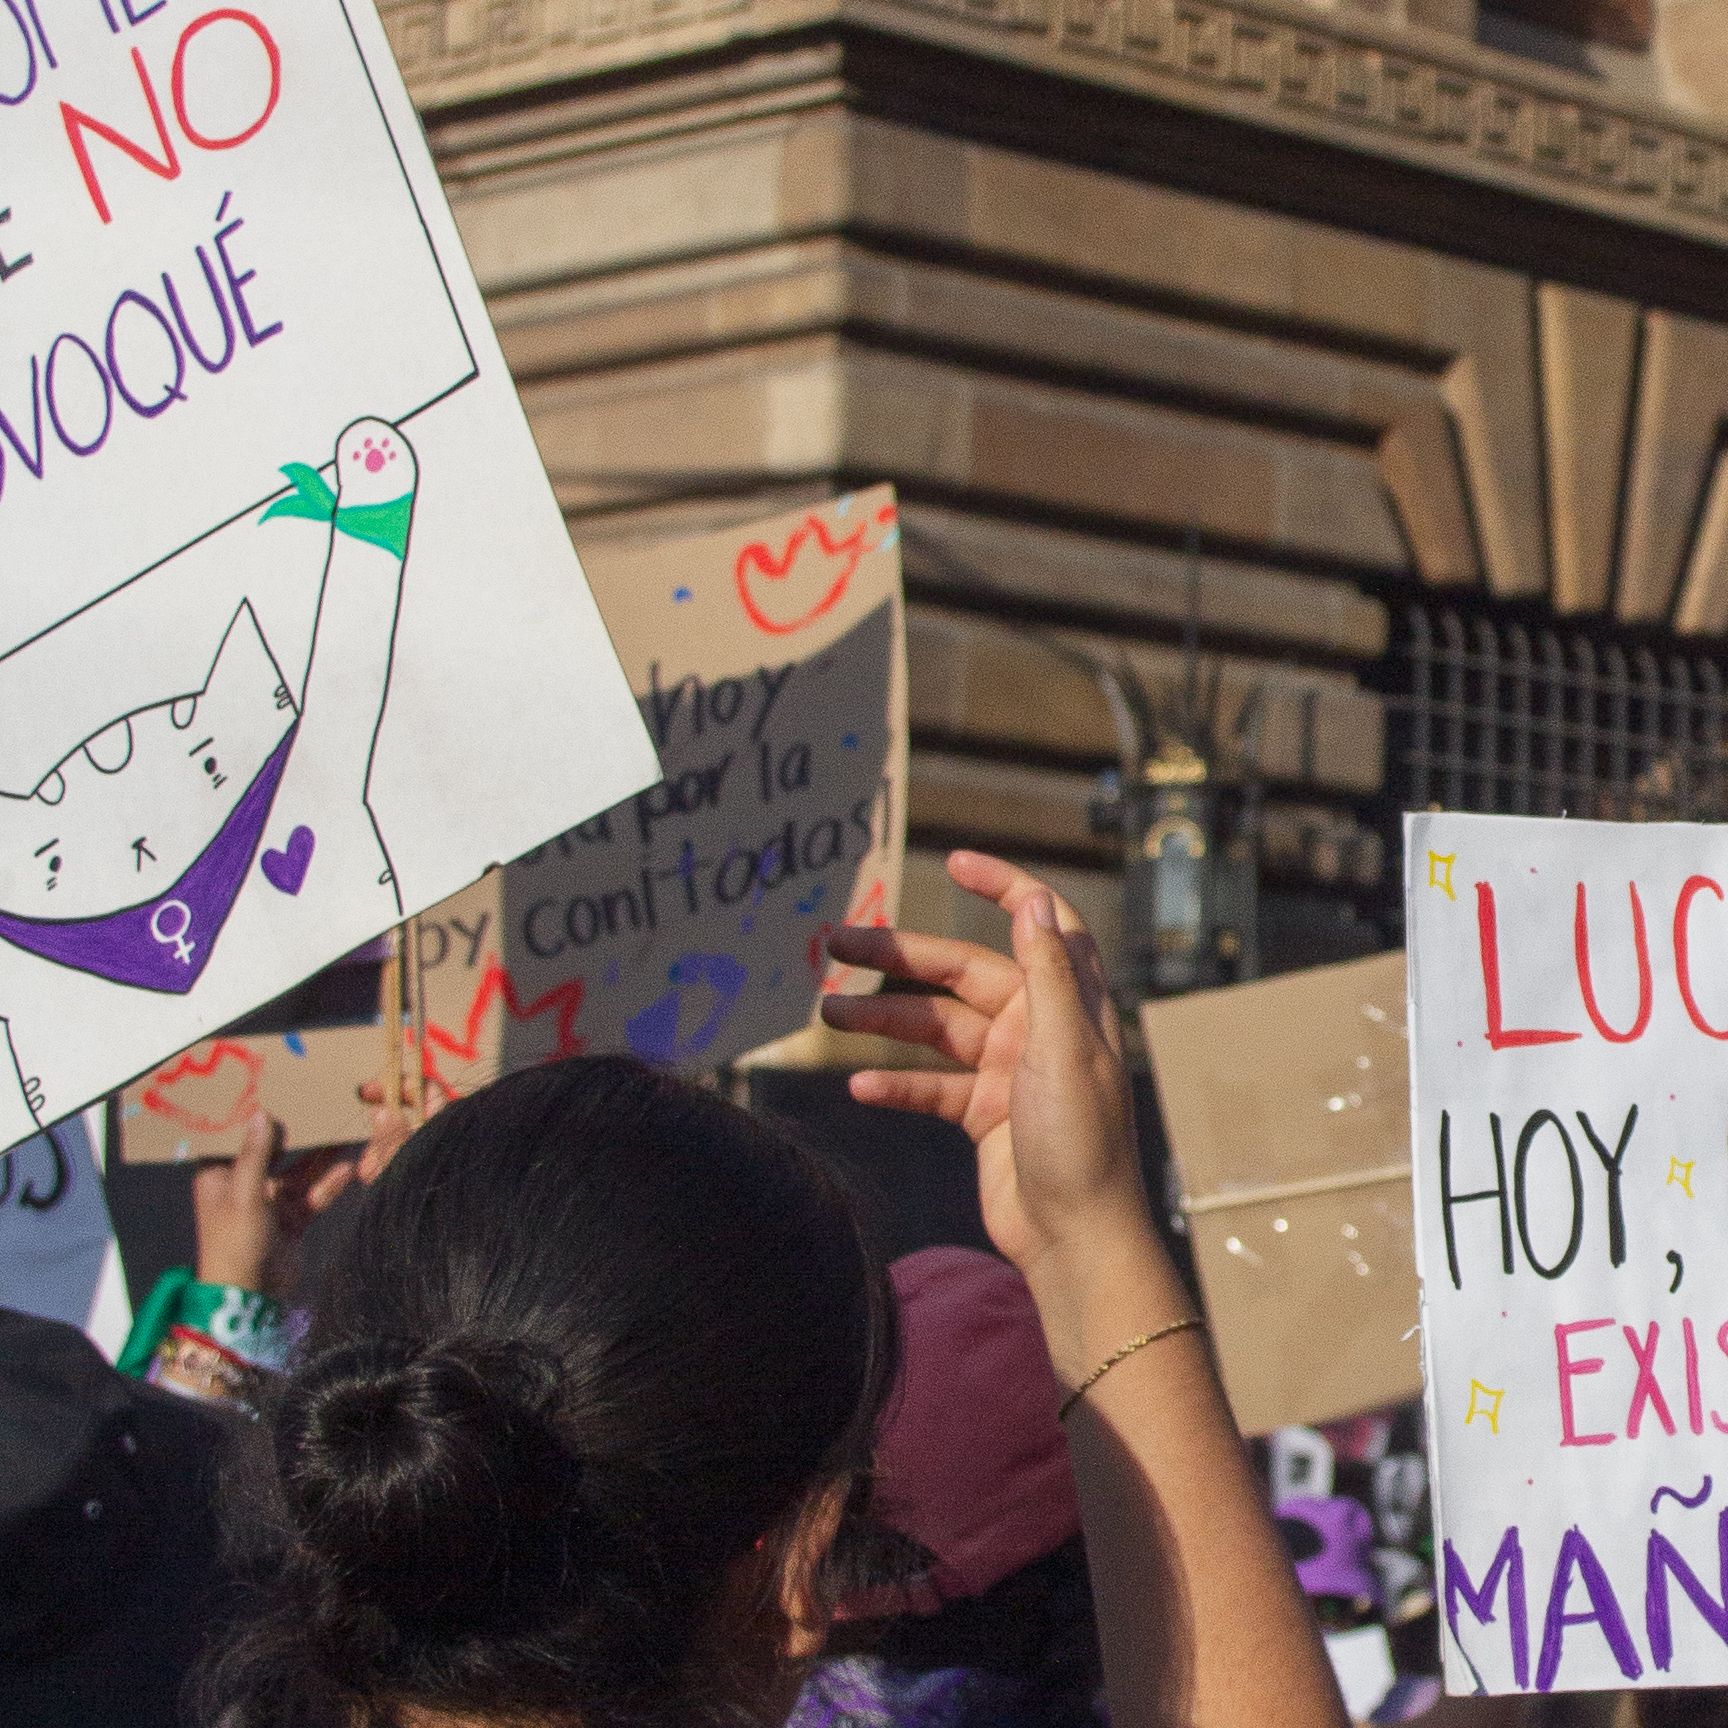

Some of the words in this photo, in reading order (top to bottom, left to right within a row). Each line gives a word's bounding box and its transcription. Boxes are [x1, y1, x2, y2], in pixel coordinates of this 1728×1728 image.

[58, 7, 282, 225] NO
[0, 189, 284, 500] VOQUÉ
[1441, 1101, 1685, 1293] HOY,
